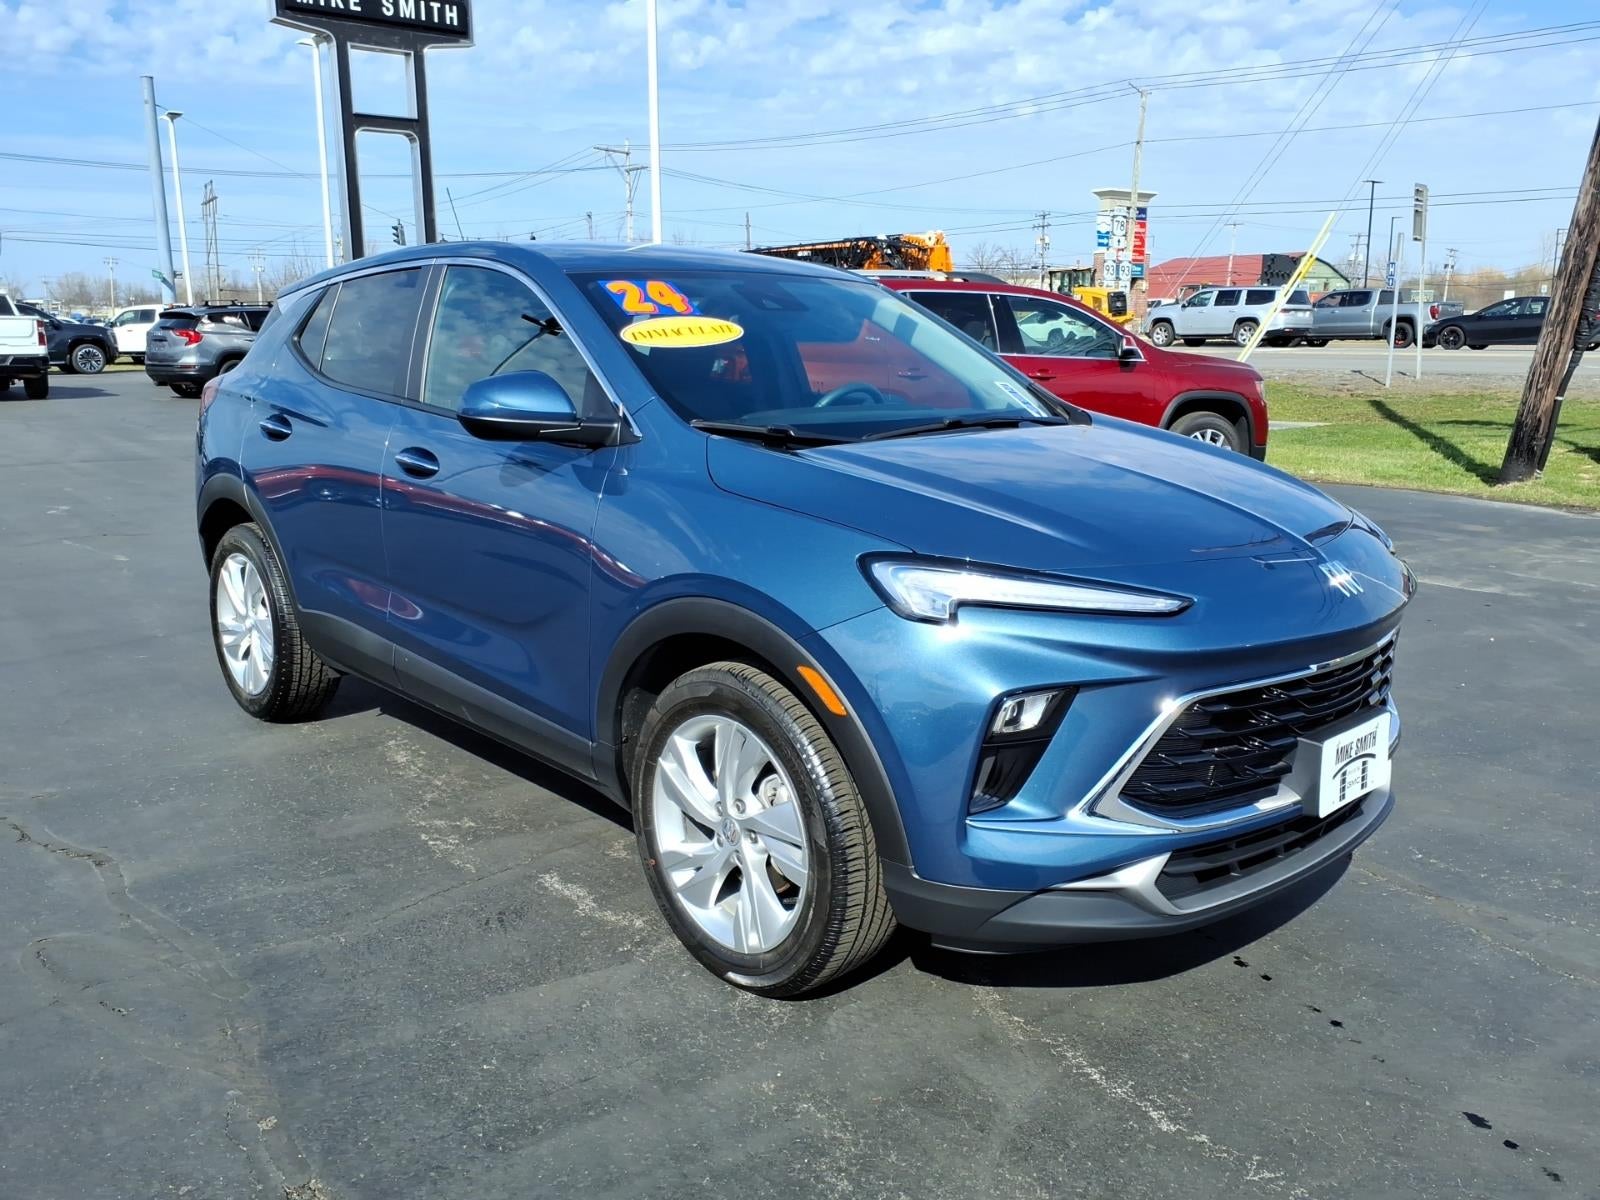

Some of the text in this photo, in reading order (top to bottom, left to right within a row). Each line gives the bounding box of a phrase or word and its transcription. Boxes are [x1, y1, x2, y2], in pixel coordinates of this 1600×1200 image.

[382, 0, 458, 26] SMITH
[1115, 220, 1125, 231] 78
[1105, 264, 1115, 276] 93
[1120, 265, 1130, 277] 93
[605, 281, 693, 314] 24
[631, 324, 734, 341] IMMACULATE
[1335, 731, 1377, 765] MIKE SMITH
